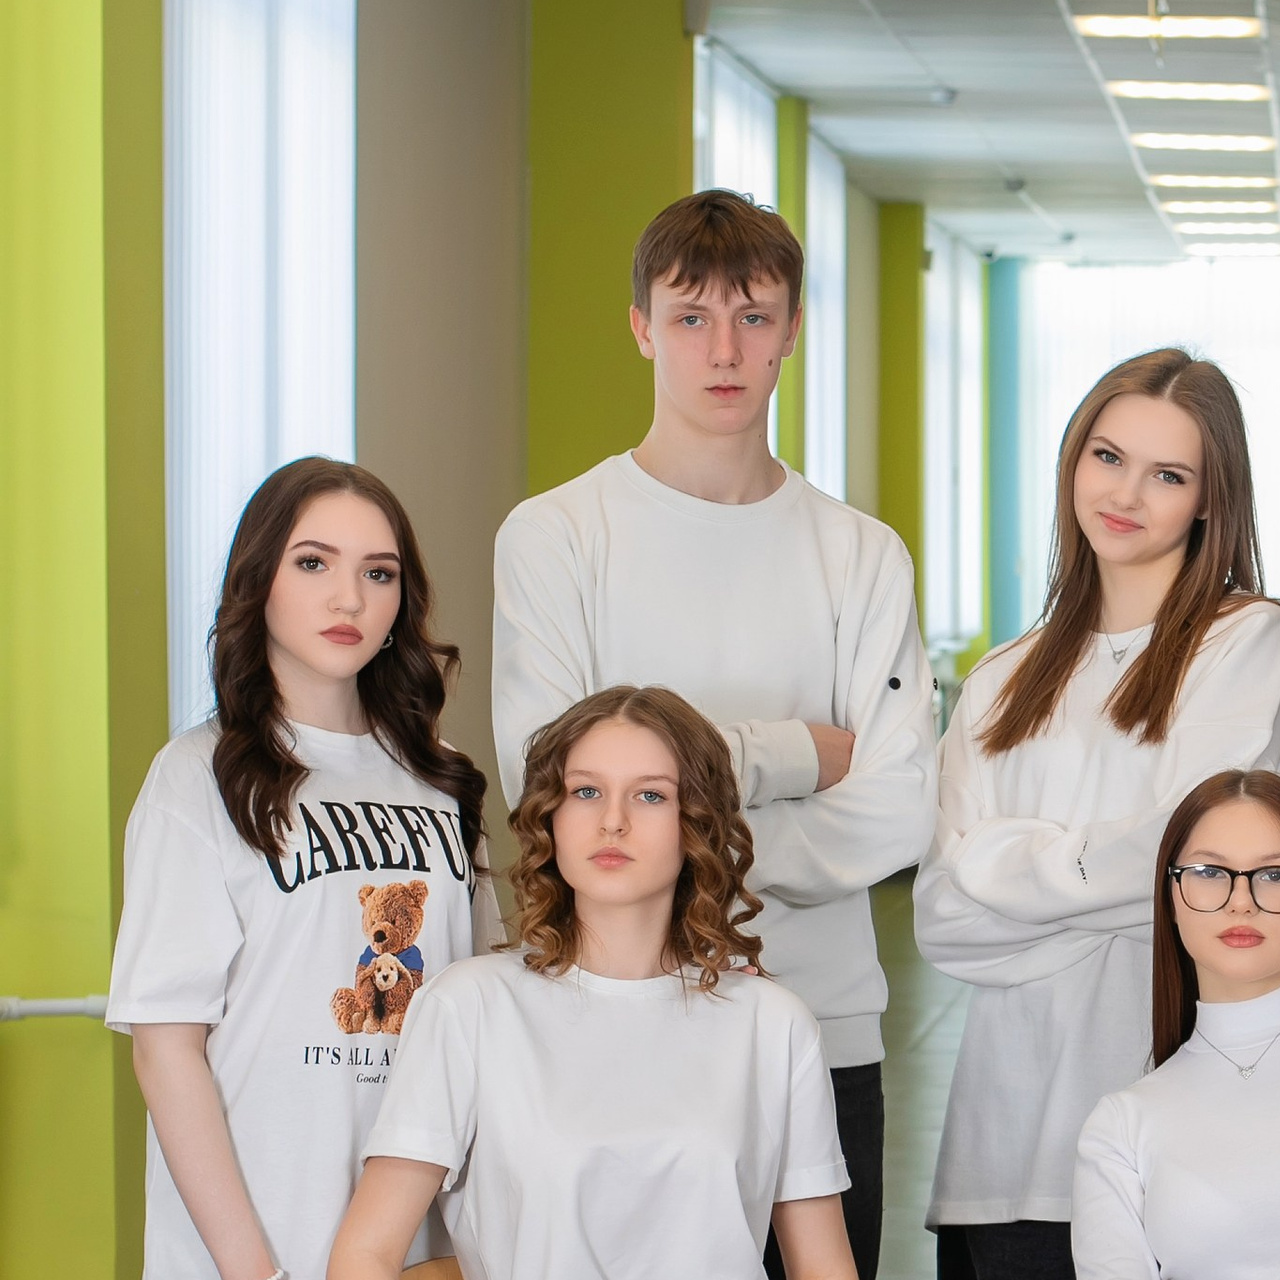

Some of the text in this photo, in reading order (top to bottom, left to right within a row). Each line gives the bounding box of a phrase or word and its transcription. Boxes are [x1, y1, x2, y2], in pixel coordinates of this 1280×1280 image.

[265, 801, 476, 904] CAREFU
[304, 1046, 397, 1066] IT'S ALL A
[356, 1073, 381, 1084] Good
